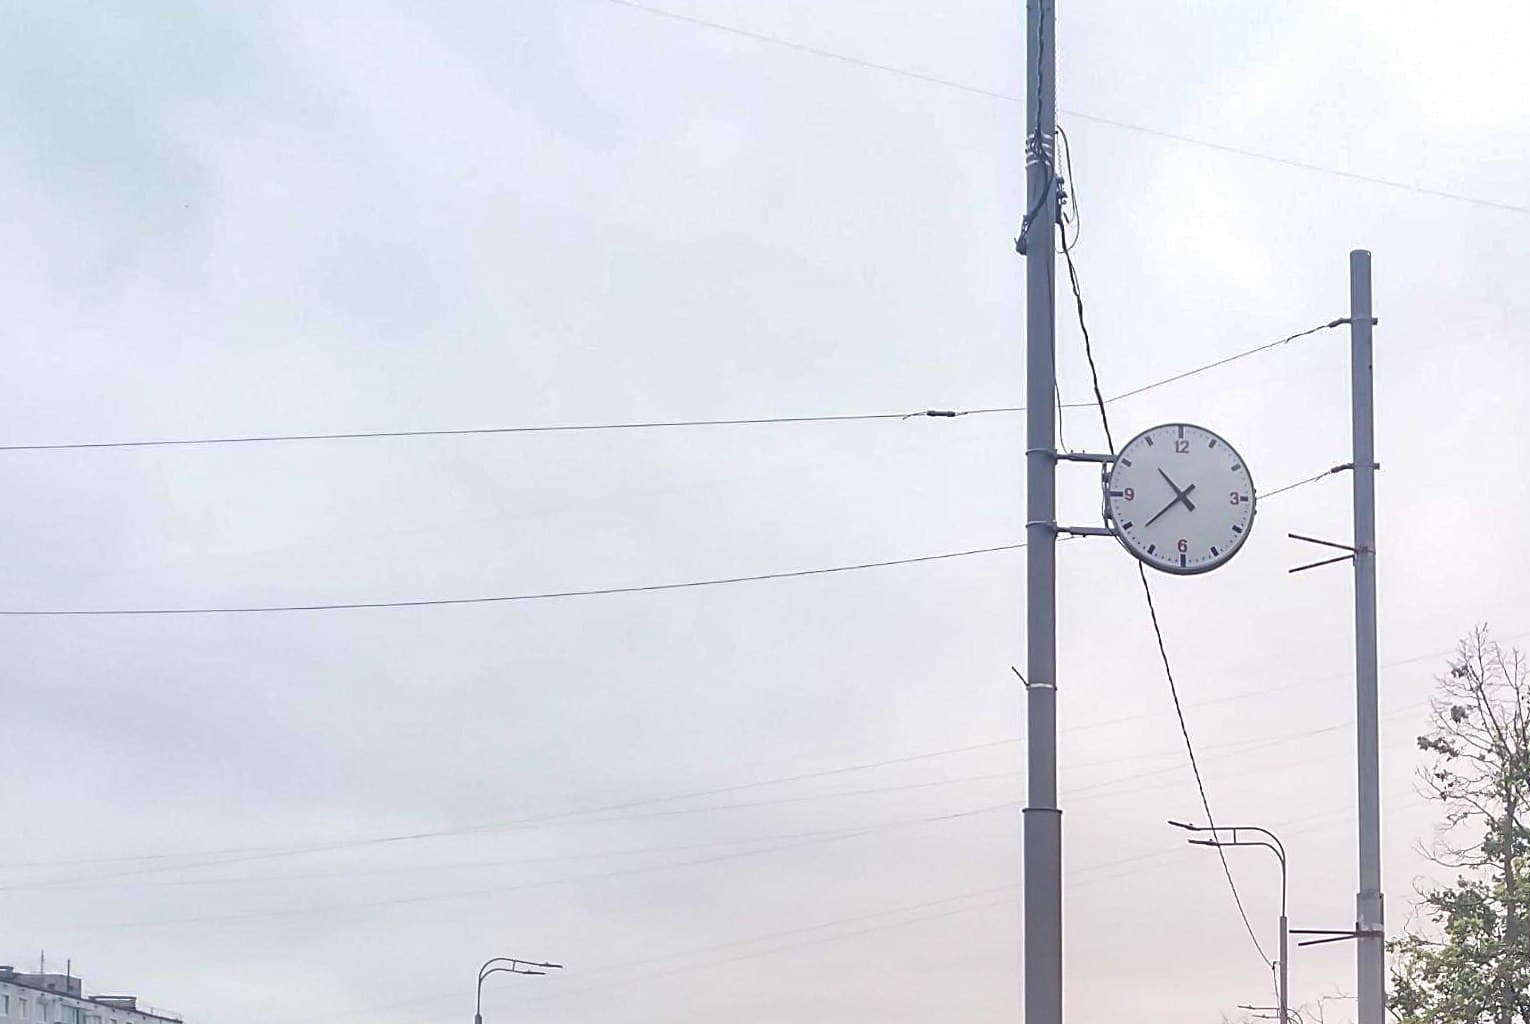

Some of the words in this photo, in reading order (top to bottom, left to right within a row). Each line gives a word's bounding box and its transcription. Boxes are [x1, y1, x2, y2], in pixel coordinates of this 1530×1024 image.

[1175, 440, 1190, 453] 12
[1124, 487, 1135, 500] 9
[1229, 492, 1240, 505] 3
[1177, 539, 1188, 553] 6
